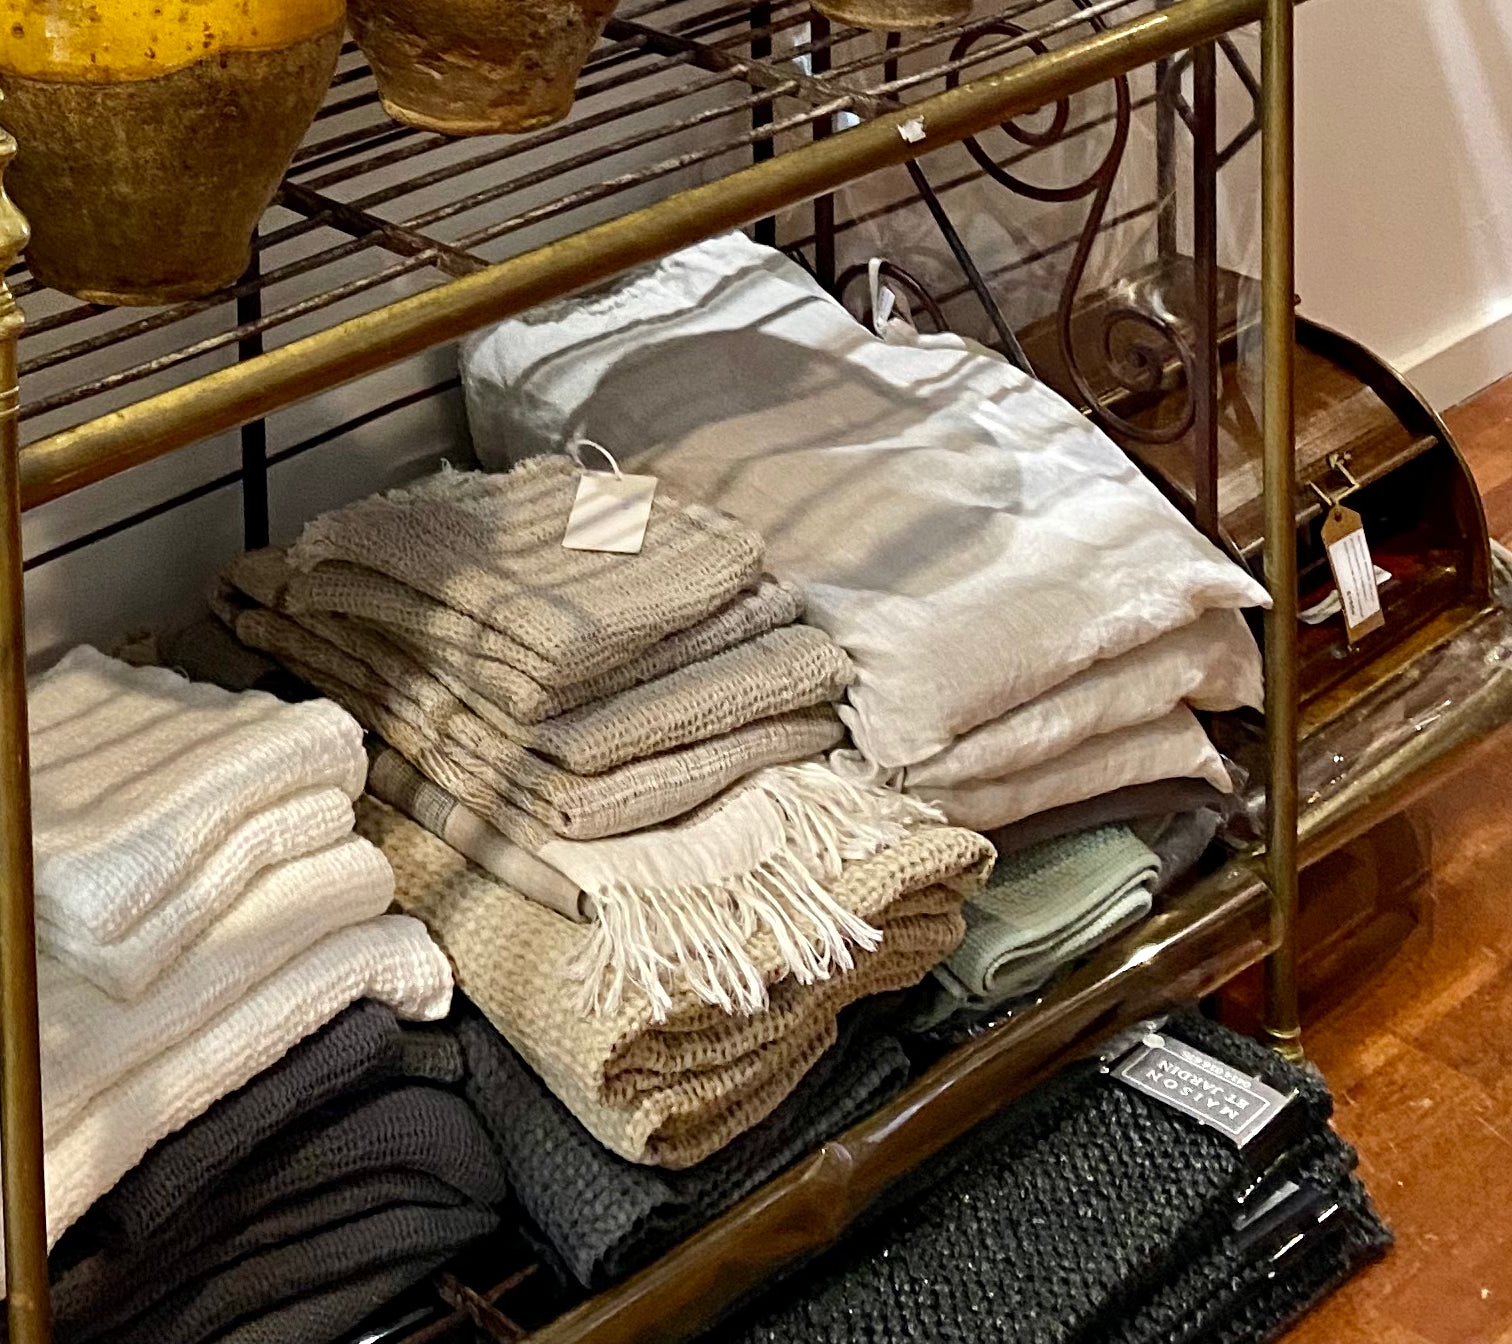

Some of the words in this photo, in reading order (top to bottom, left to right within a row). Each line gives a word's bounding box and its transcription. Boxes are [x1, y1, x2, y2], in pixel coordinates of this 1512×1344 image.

[1146, 1069, 1239, 1119] MAISON
[1157, 1060, 1224, 1094] JARDIN
[1223, 1094, 1250, 1109] ET
